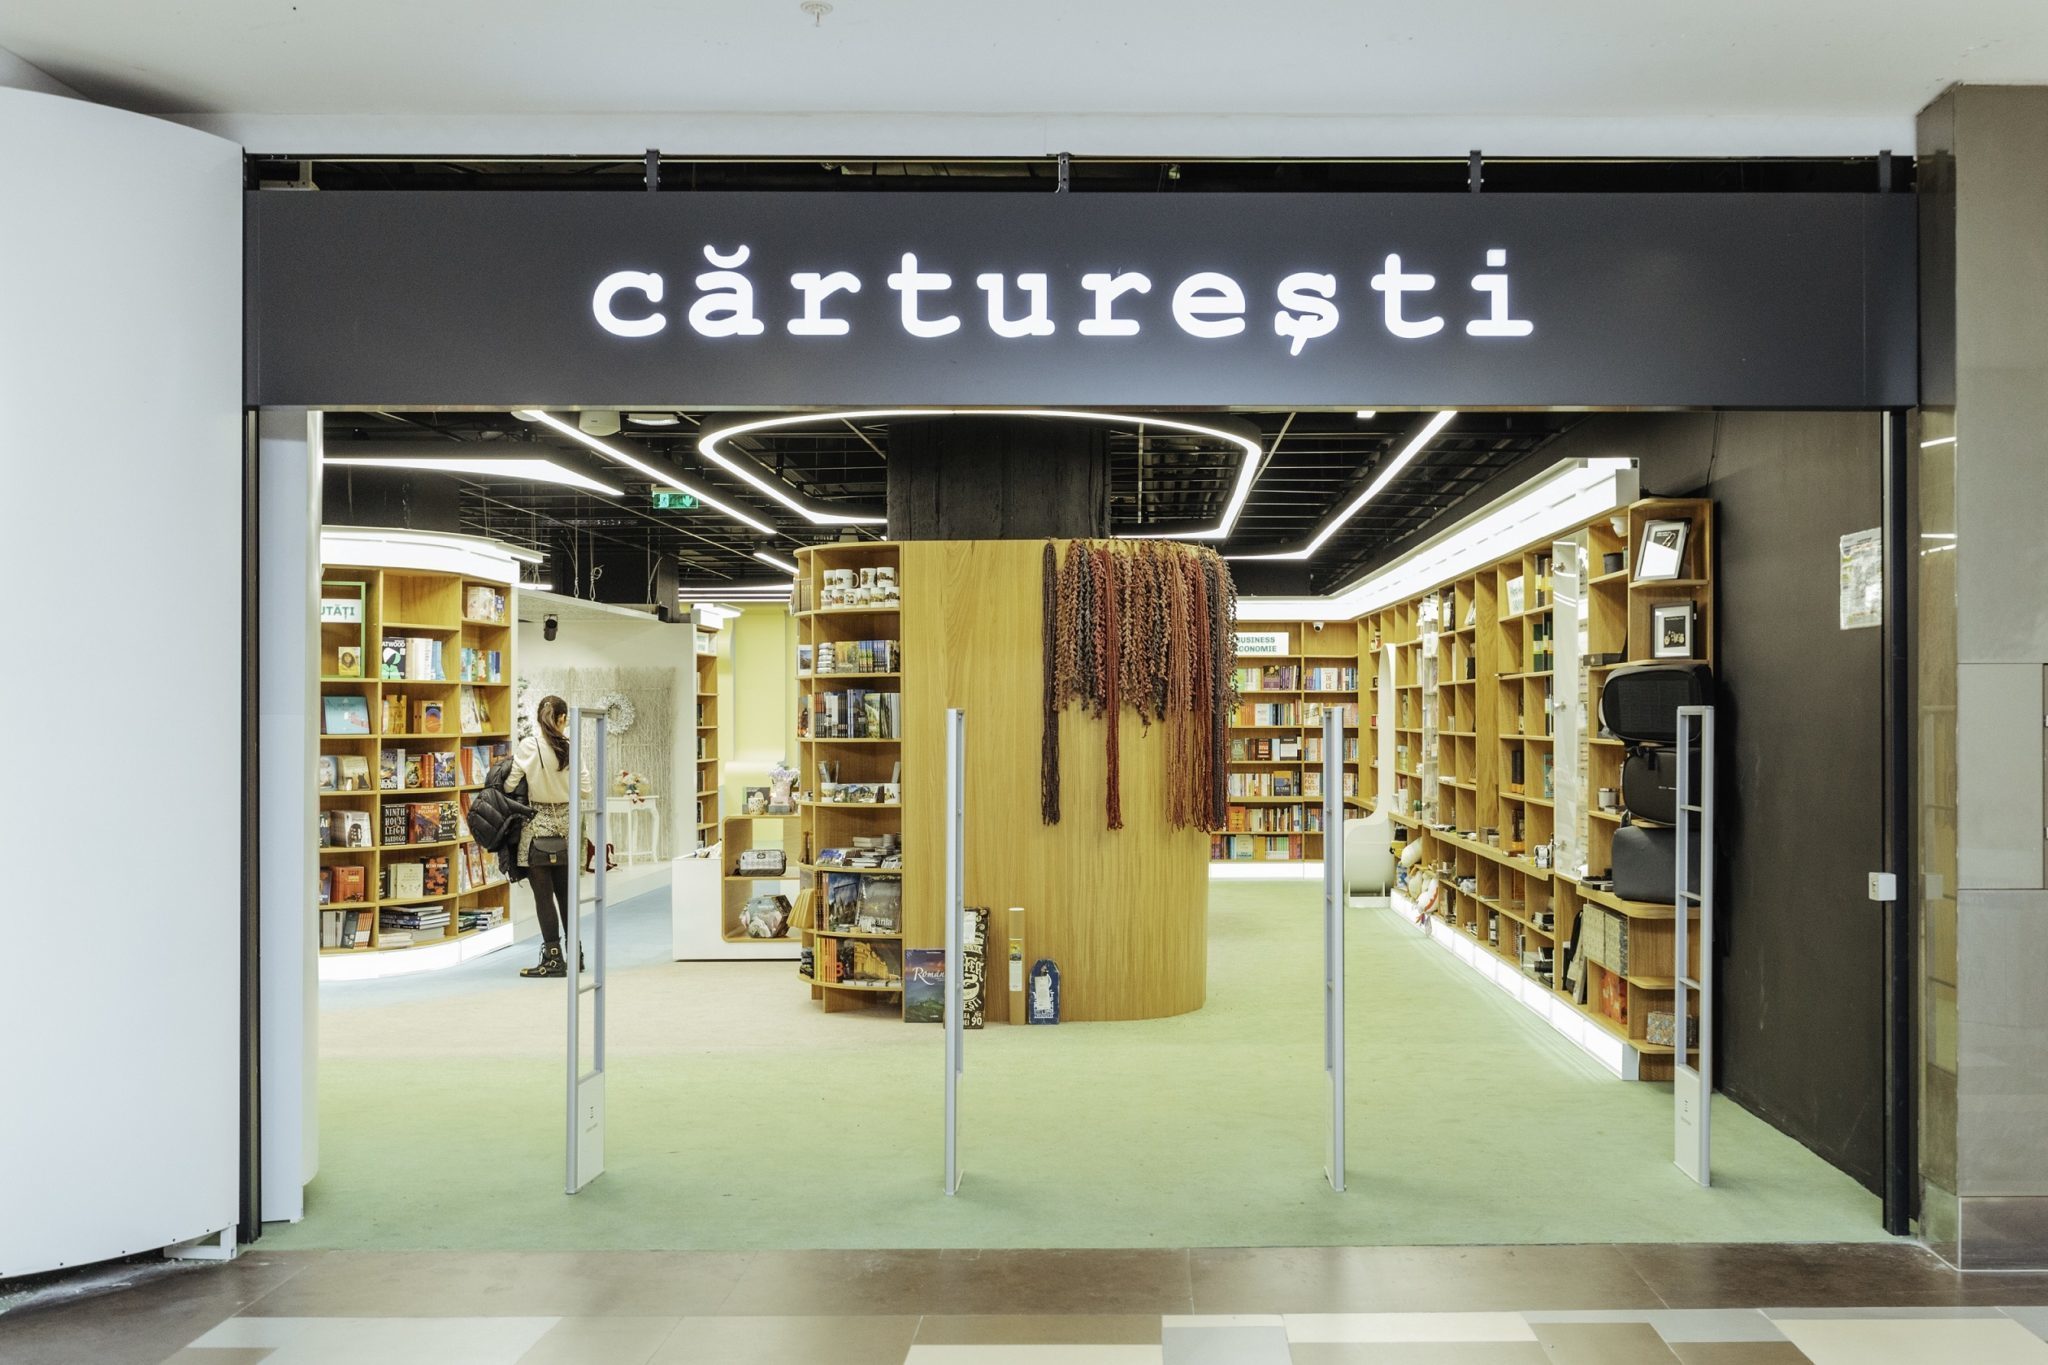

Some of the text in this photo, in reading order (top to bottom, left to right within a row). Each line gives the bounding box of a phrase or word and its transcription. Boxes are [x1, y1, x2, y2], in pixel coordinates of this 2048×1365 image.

[592, 244, 1534, 357] cărturești
[1238, 645, 1277, 653] CONOMIE
[384, 807, 406, 816] NINTH
